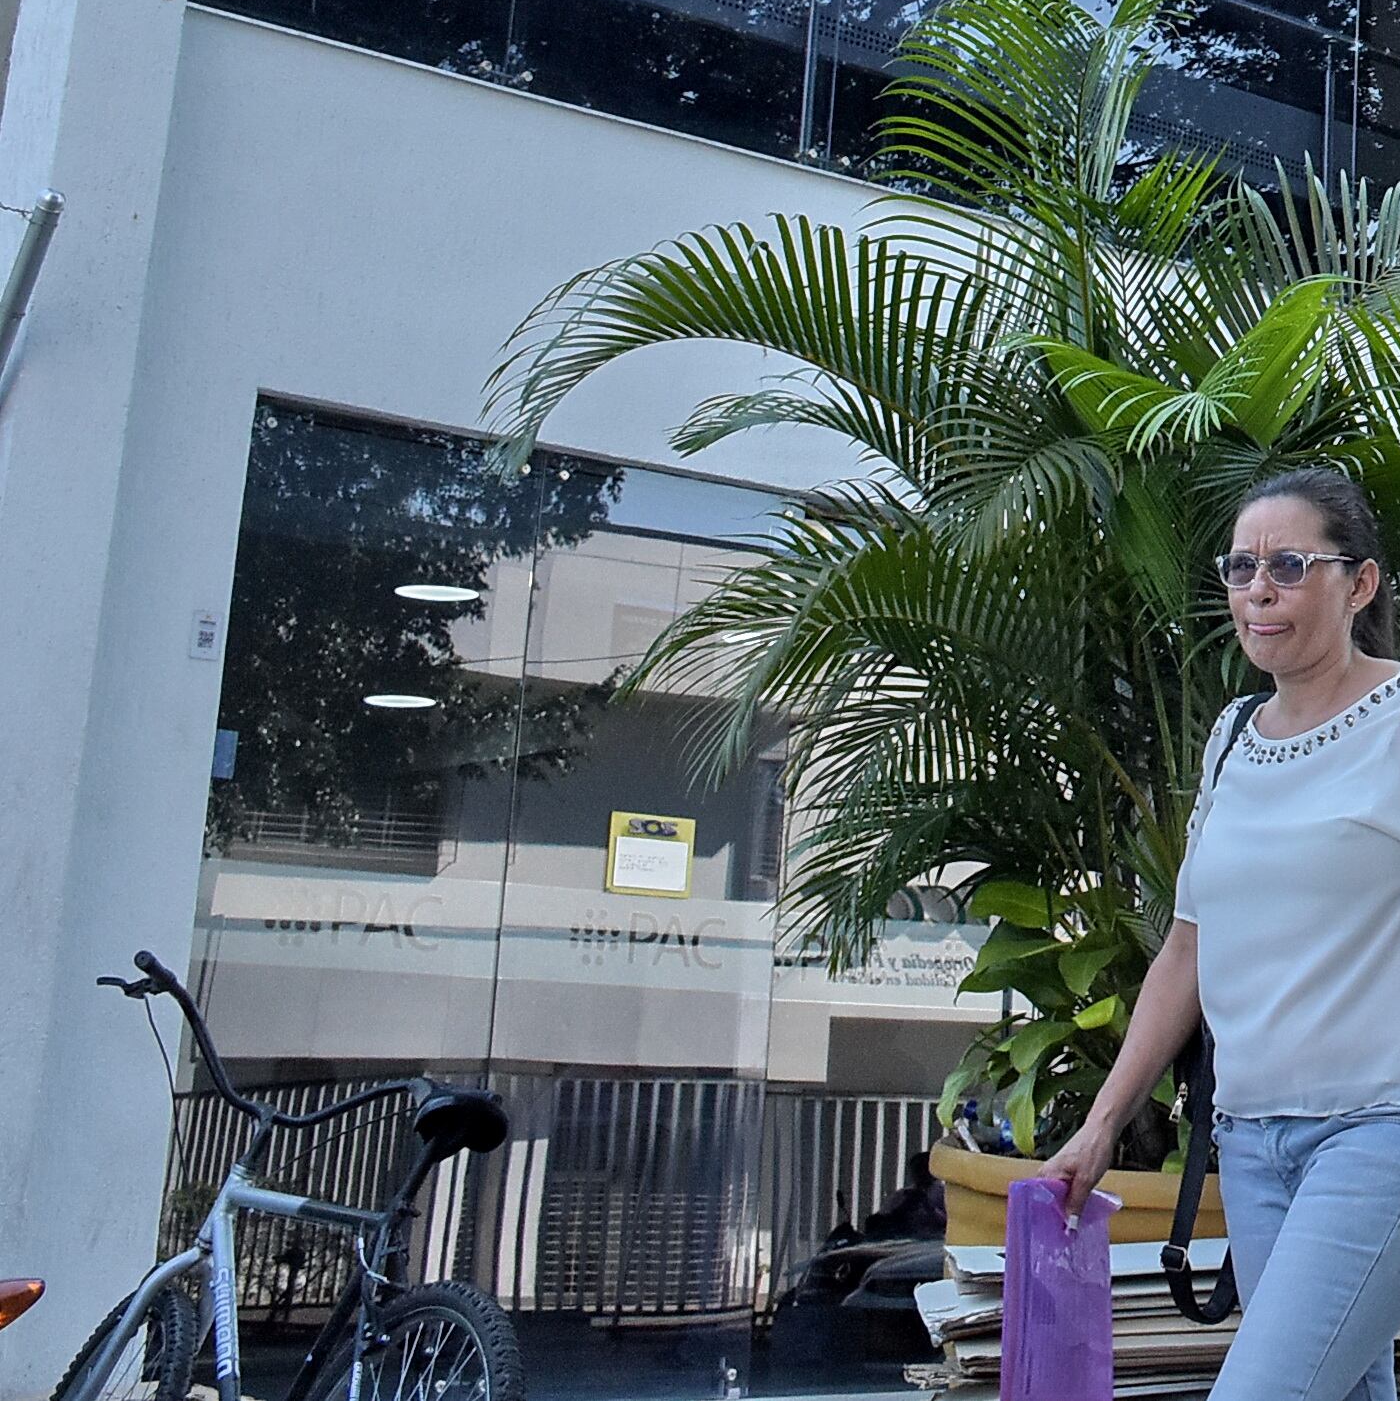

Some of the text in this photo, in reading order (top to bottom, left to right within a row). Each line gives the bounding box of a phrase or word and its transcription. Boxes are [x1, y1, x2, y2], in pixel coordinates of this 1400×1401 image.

[628, 818, 679, 837] SOS
[331, 889, 444, 951] PAC
[627, 910, 726, 970] PAC
